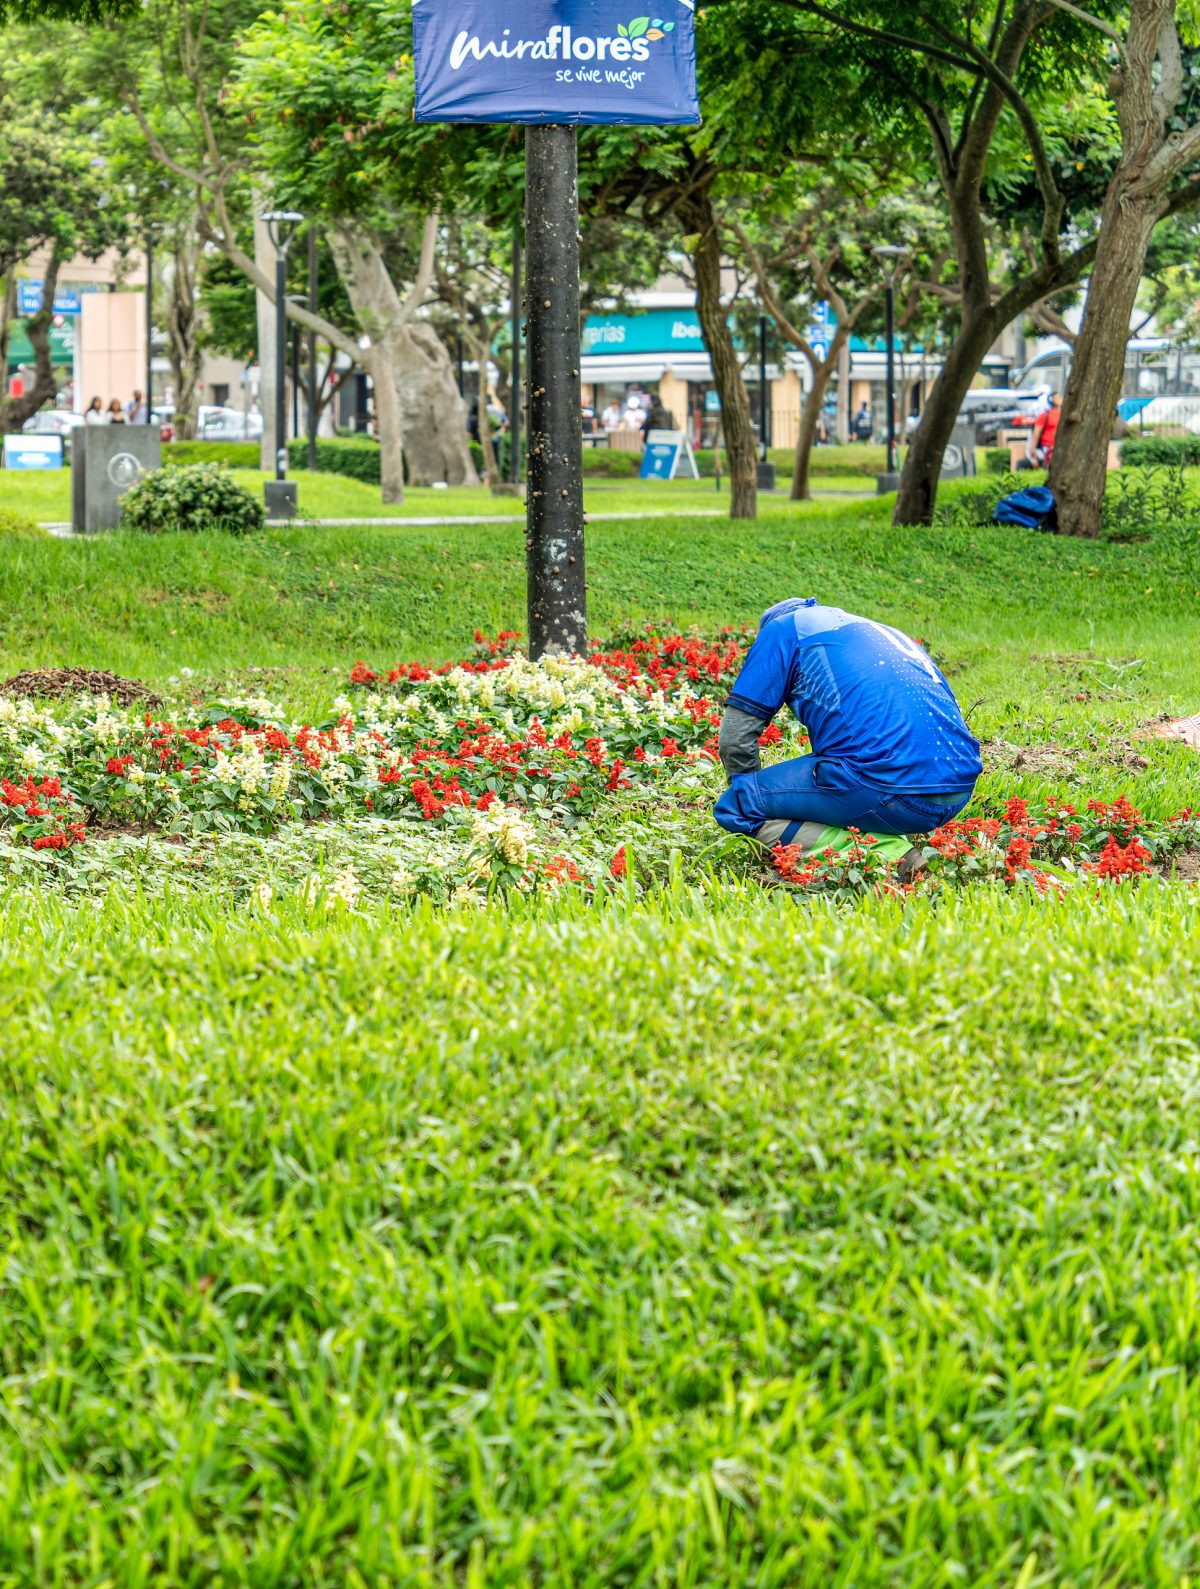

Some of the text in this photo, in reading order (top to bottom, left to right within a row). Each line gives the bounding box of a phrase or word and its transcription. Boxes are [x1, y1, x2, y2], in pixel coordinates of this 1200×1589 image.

[555, 66, 646, 89] se vive mejor
